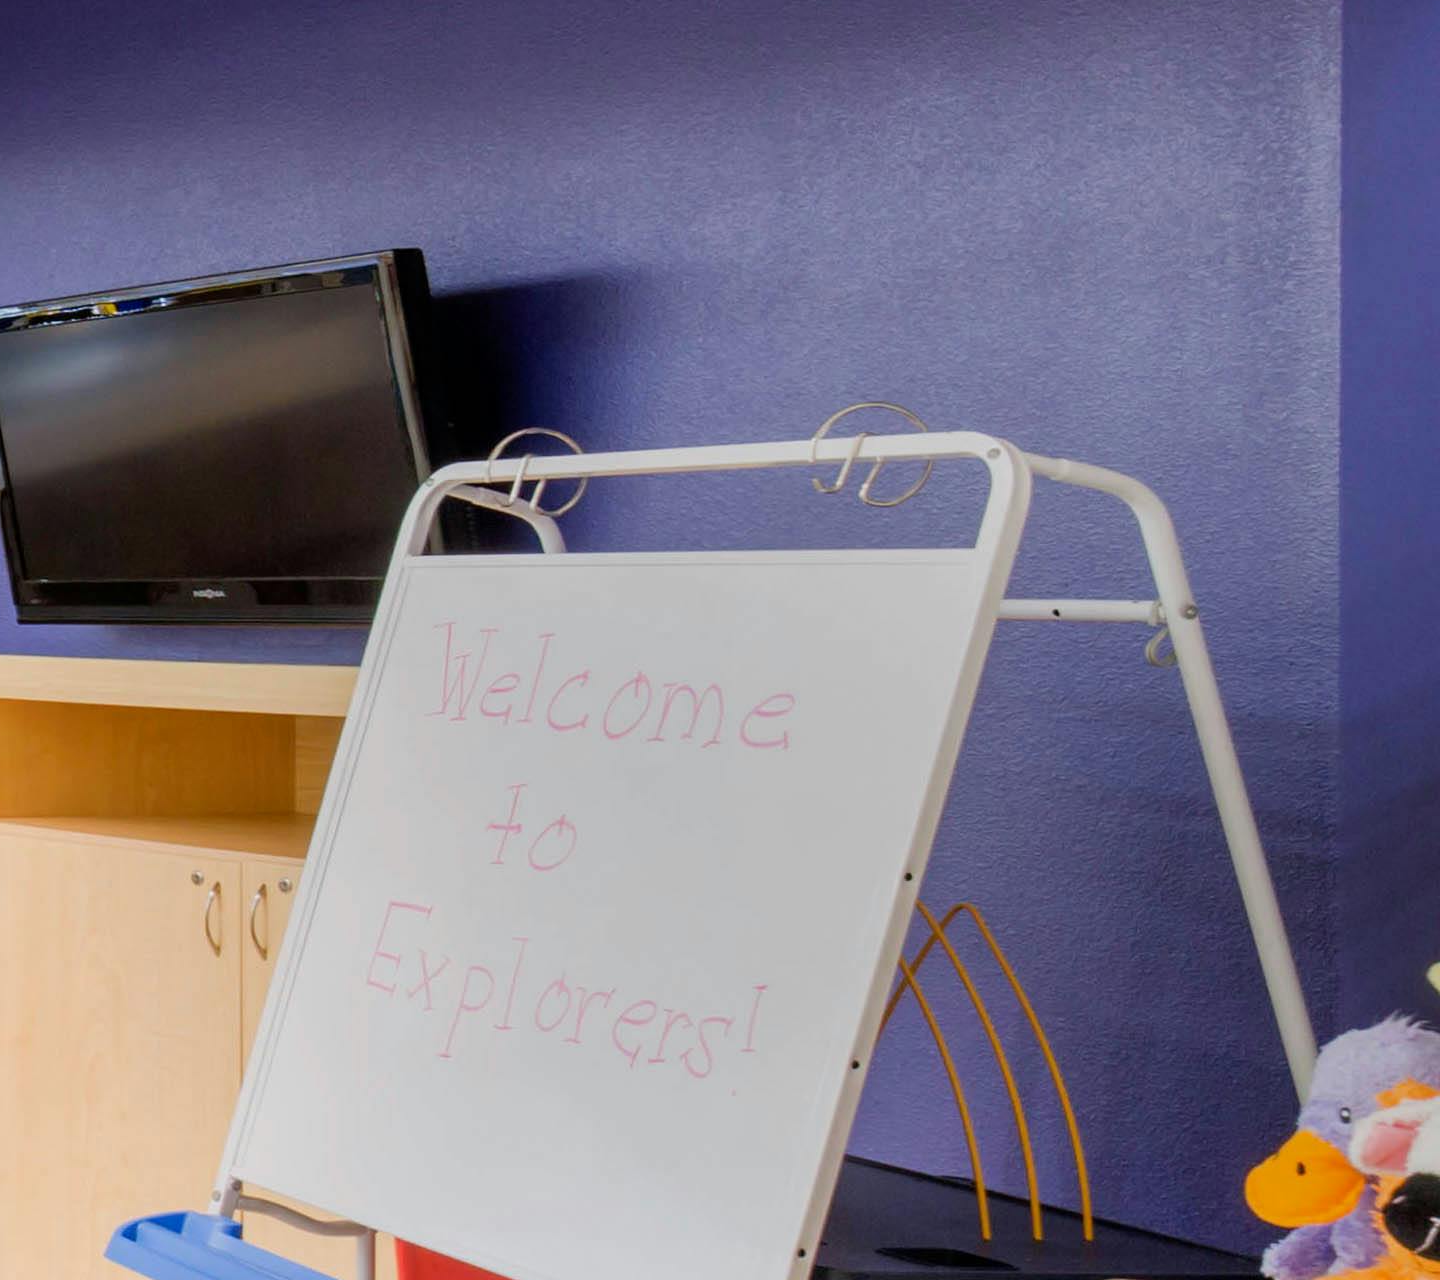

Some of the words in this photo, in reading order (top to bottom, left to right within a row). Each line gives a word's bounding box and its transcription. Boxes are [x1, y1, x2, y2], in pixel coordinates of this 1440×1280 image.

[424, 620, 798, 751] Welcome
[486, 783, 578, 872] to
[365, 900, 768, 1097] Explorers!
